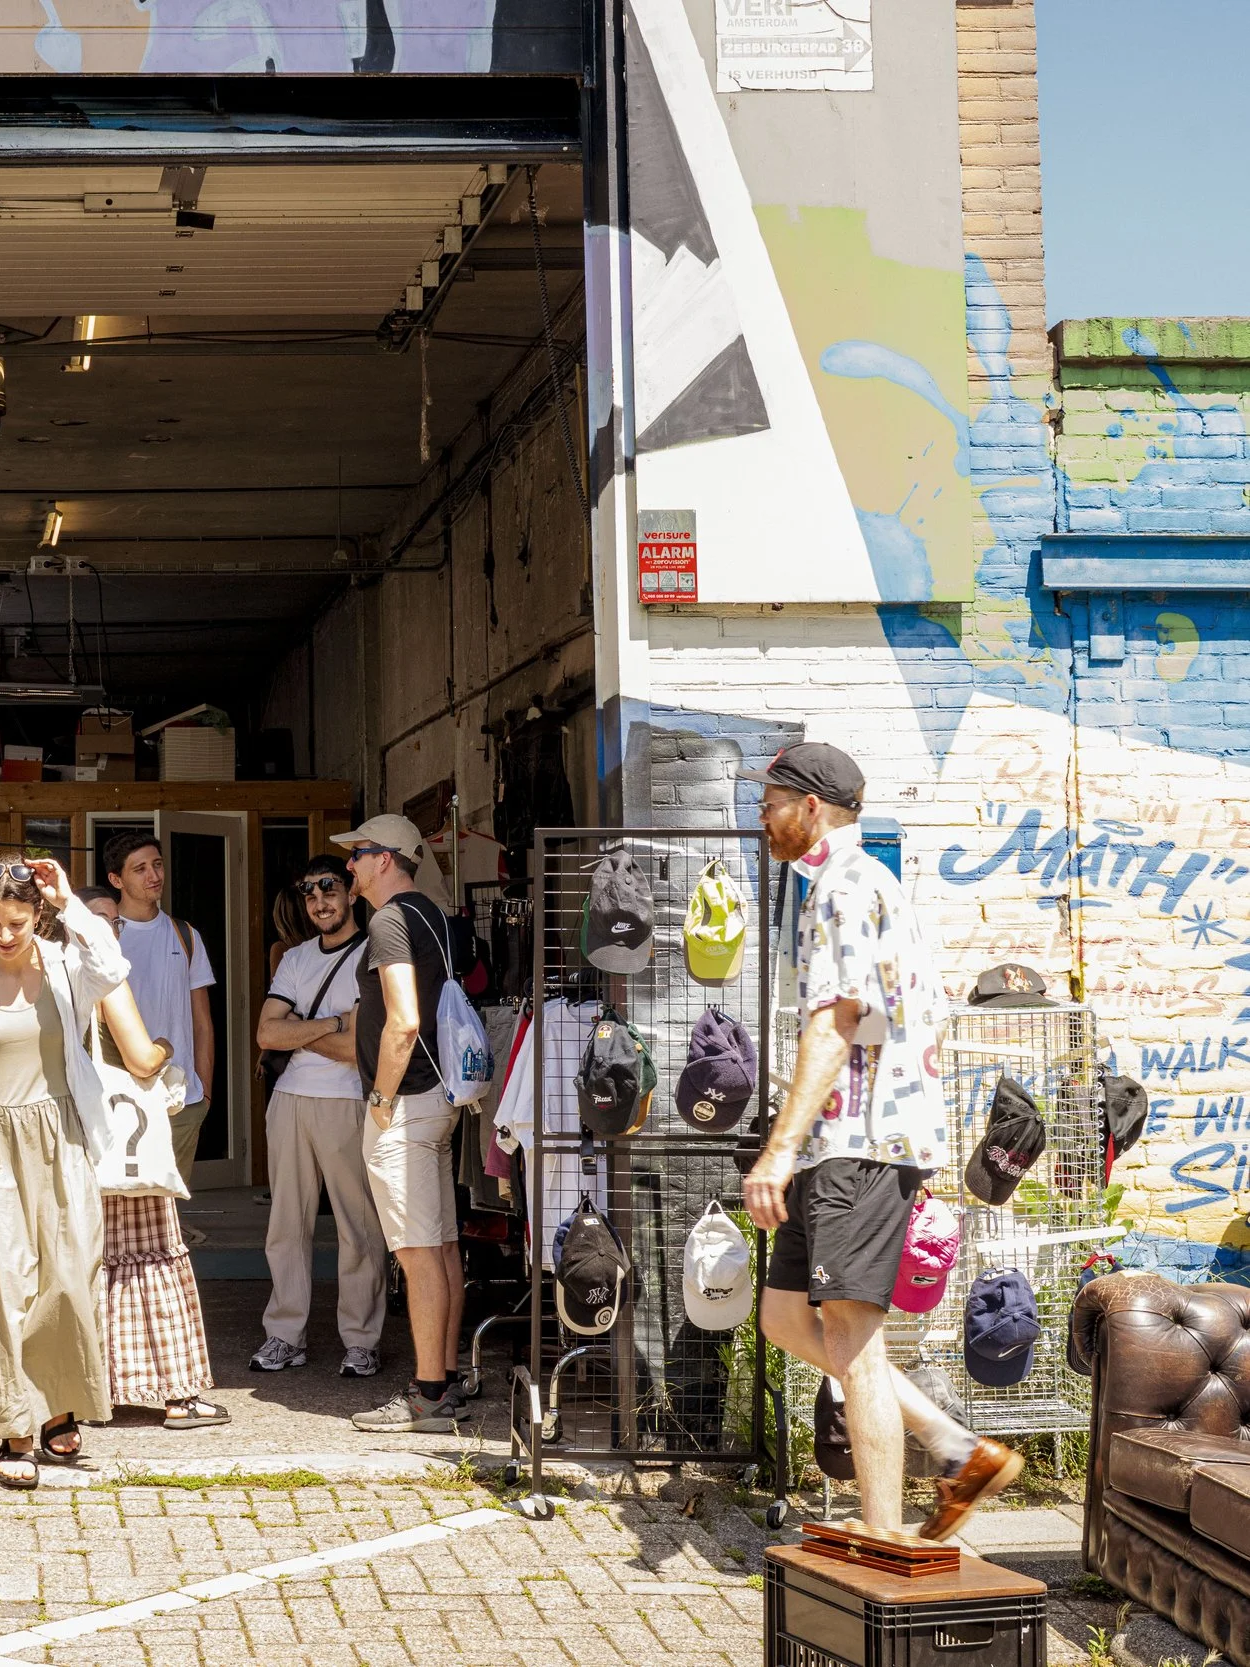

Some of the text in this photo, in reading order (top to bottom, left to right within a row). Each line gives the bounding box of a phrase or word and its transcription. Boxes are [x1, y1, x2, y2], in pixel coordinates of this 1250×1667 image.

[727, 18, 798, 28] AMSTERDAM
[723, 42, 838, 54] ZEEBURGERPAD
[729, 70, 818, 80] IS VERHUISD
[644, 531, 691, 540] verisure
[641, 546, 695, 559] ALARM
[1140, 1035, 1250, 1081] WALK
[1193, 1095, 1250, 1137] WI
